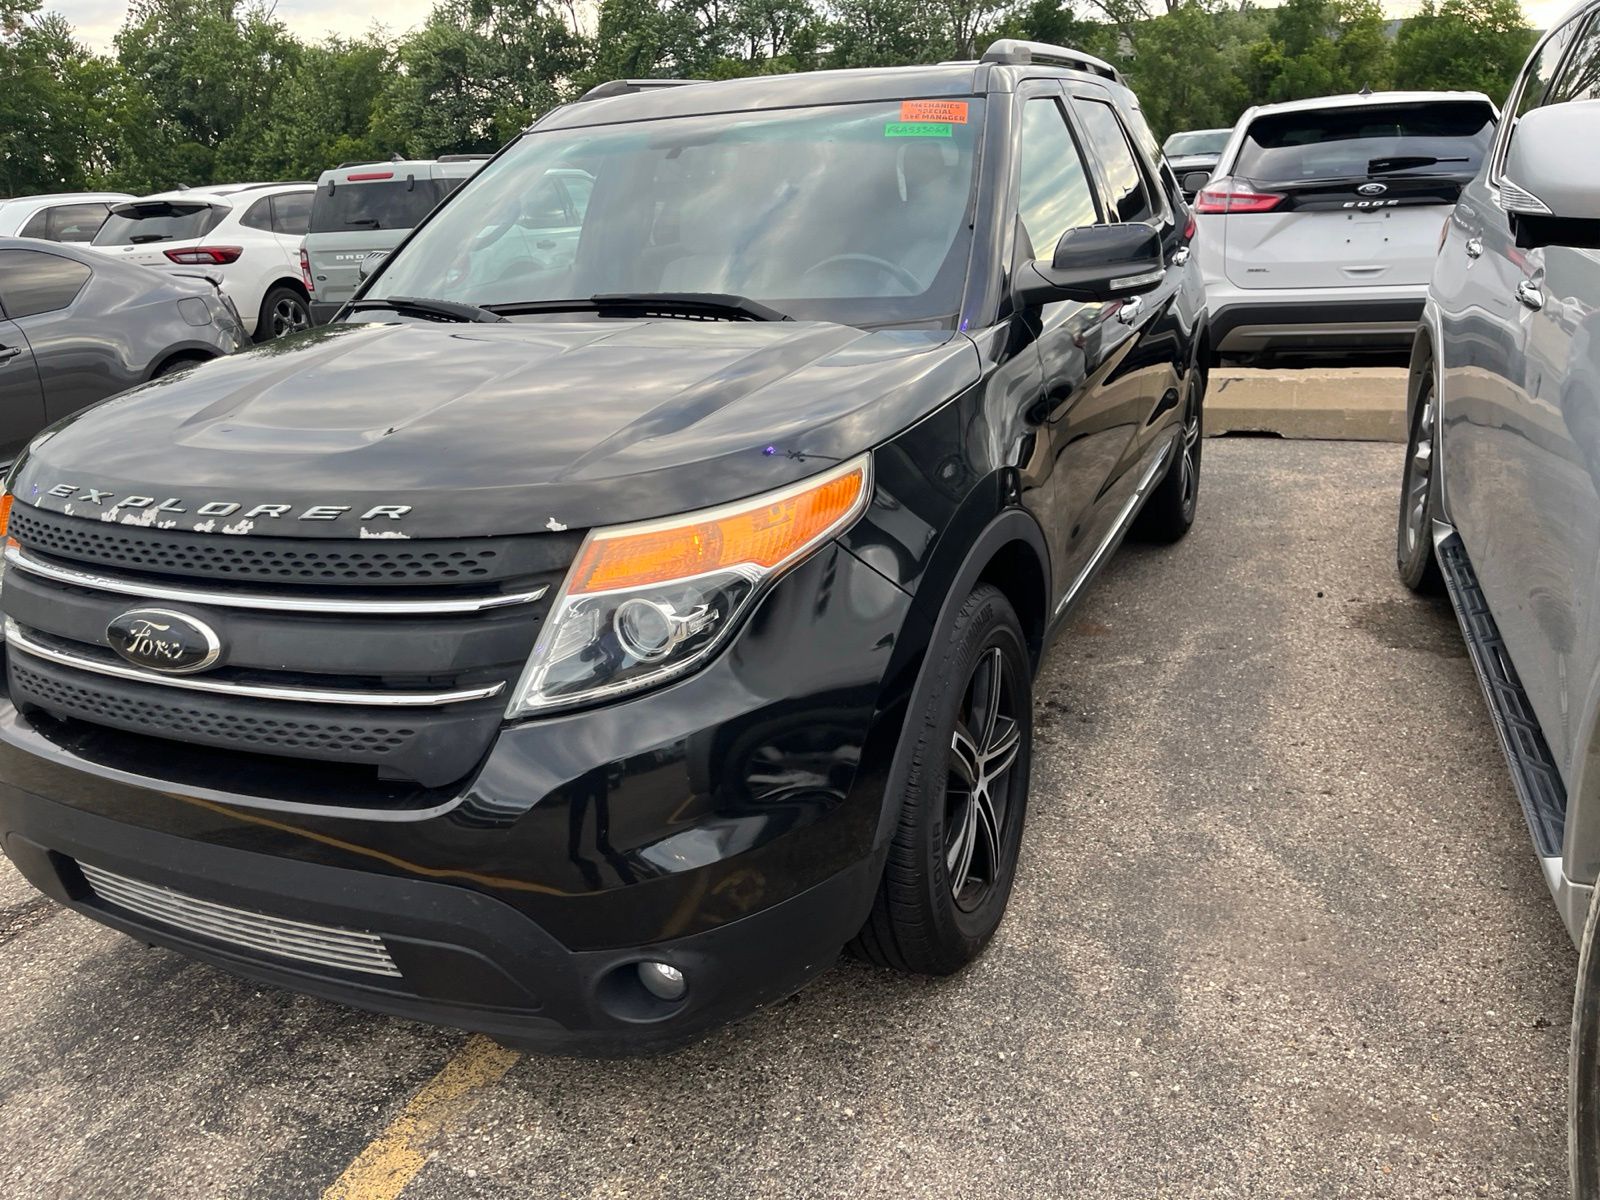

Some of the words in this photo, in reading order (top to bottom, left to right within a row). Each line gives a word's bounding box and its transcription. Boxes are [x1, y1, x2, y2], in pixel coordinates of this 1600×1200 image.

[921, 114, 966, 122] MANAGER
[1343, 200, 1399, 208] EDGE
[47, 483, 413, 520] EXPLORER
